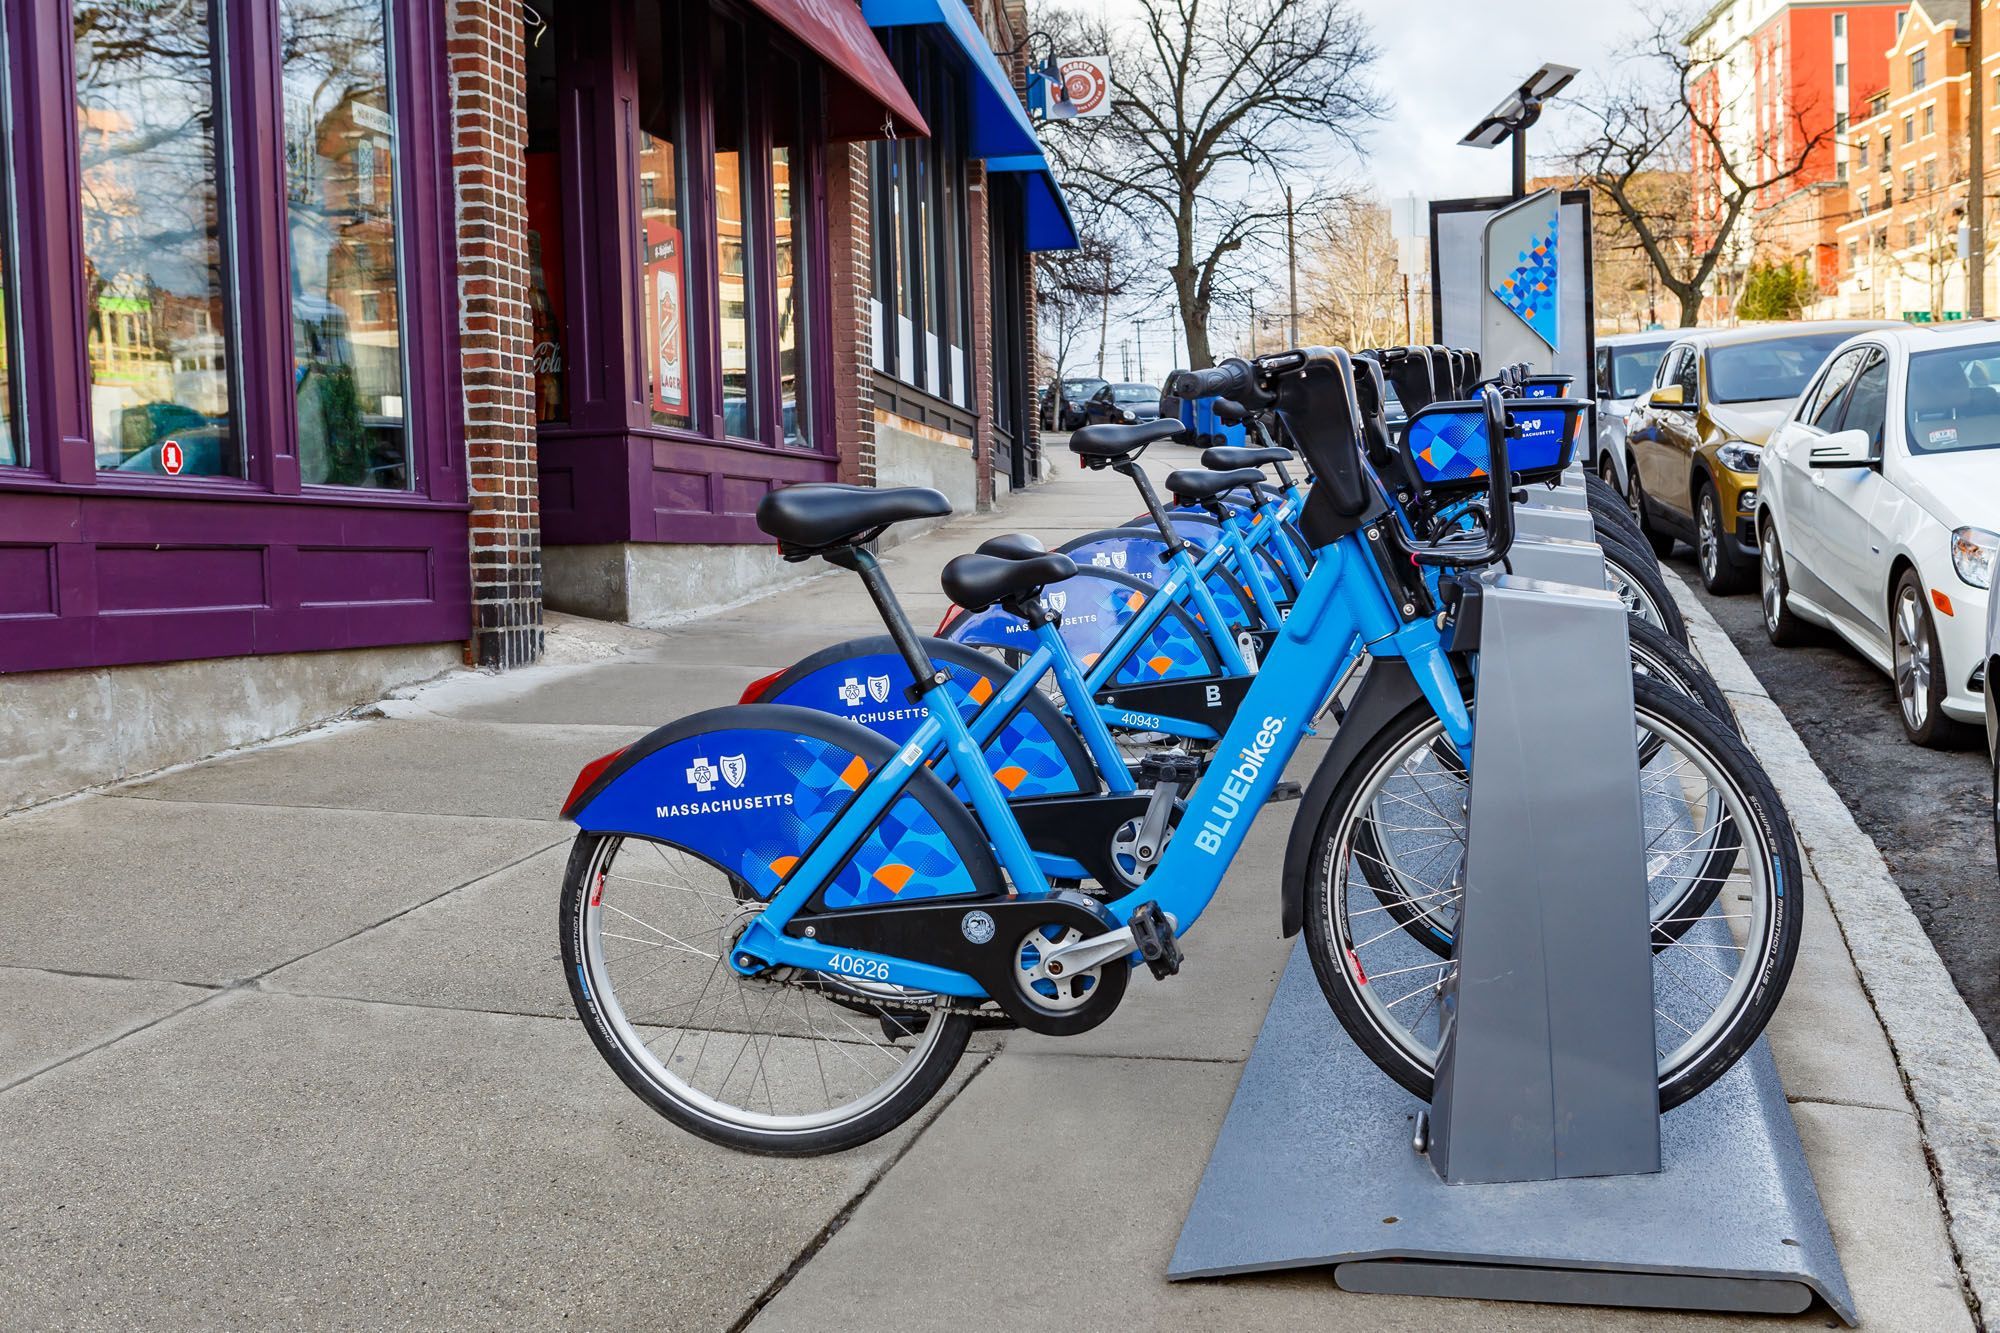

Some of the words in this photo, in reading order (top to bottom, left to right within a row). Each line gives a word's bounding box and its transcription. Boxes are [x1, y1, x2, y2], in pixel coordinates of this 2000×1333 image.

[661, 375, 681, 390] LAGER
[1006, 614, 1097, 634] MASSETTS
[1205, 685, 1222, 707] B
[842, 707, 929, 724] ACHUSETTS
[1121, 713, 1160, 729] 40943
[1194, 715, 1285, 856] BLUEbikes
[656, 793, 793, 818] MASSACHUSETTS
[1750, 795, 1778, 855] SCHWALBE
[1322, 836, 1334, 875] 50-559
[1383, 873, 1398, 896] PLUS
[574, 916, 582, 963] MARATHON
[1771, 898, 1784, 956] MARATHON
[828, 953, 890, 980] 40626
[1763, 958, 1775, 987] PLUS
[588, 1000, 618, 1050] SCHWALBE
